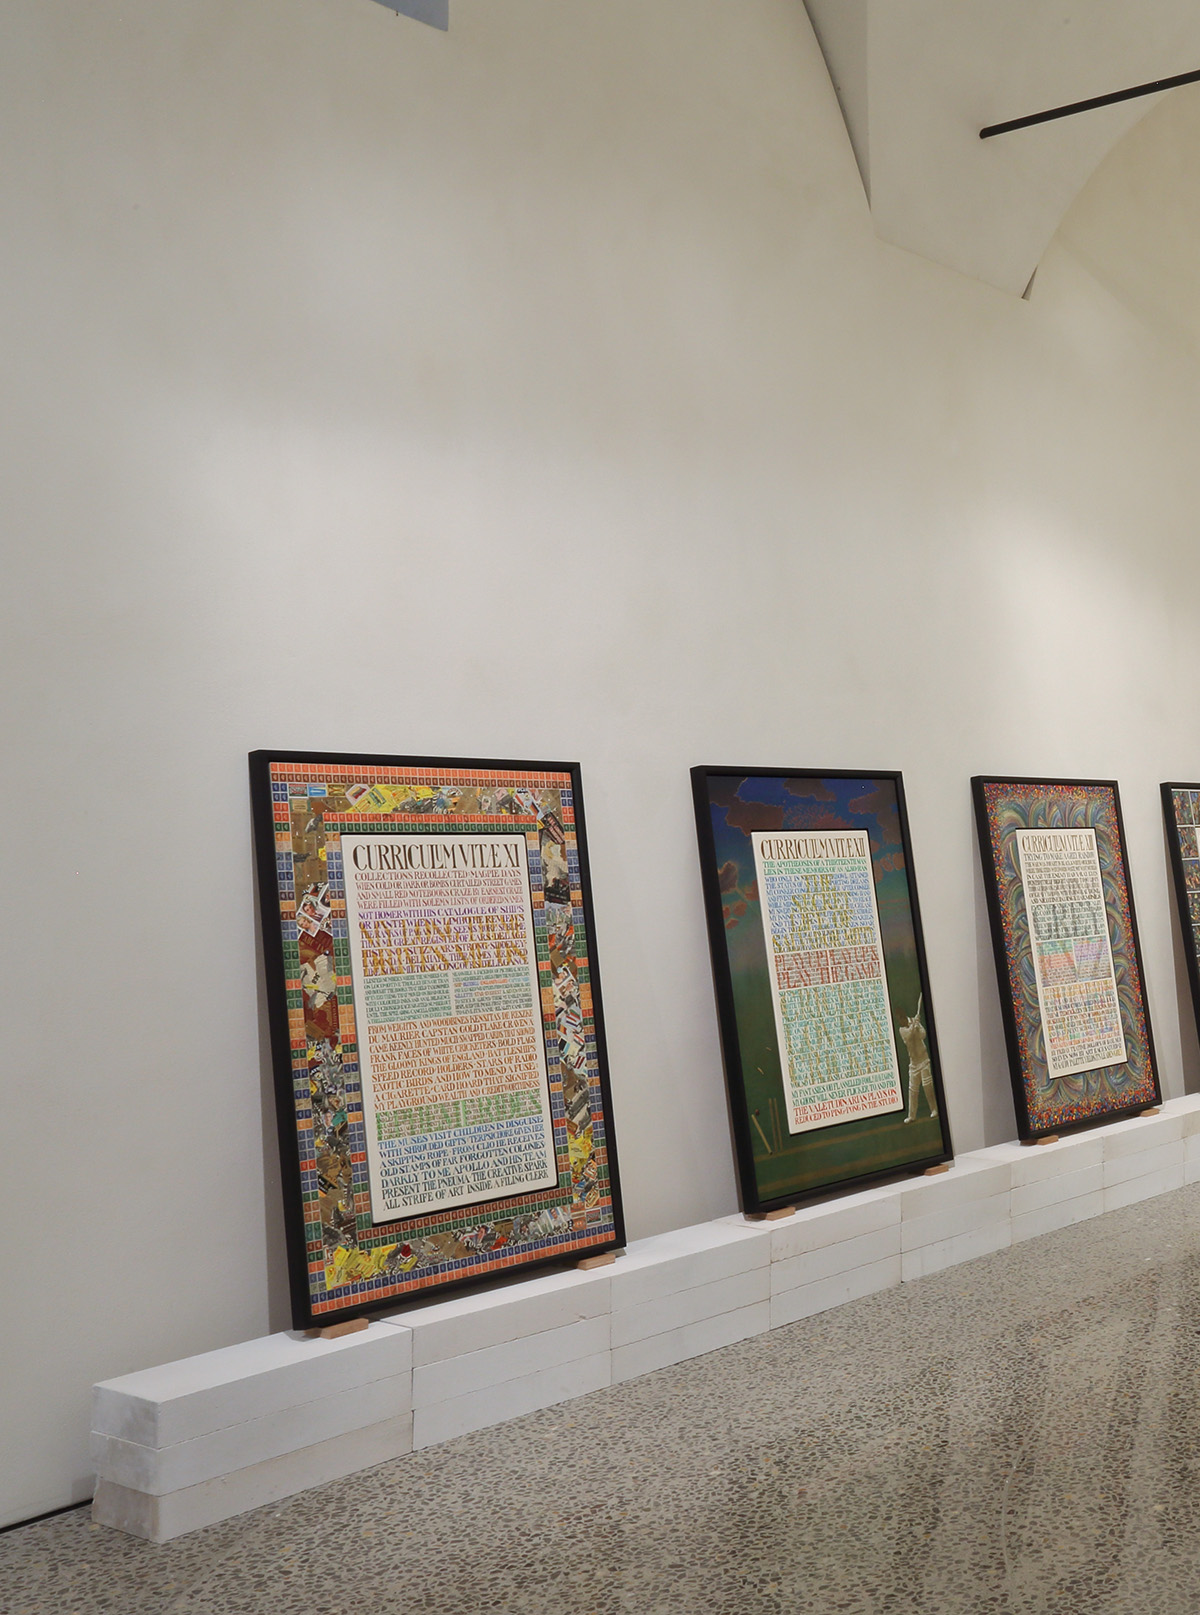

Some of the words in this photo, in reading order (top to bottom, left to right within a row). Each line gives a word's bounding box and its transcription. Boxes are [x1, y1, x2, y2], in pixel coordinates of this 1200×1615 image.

[352, 844, 457, 871] CURRICULUM
[503, 844, 520, 868] XI
[760, 839, 829, 860] CURRICULUM
[354, 871, 413, 881] COLLECTIONS
[501, 869, 521, 877] DAYS
[358, 911, 373, 920] NOT
[374, 910, 403, 919] HOMER
[403, 909, 423, 918] WITH
[424, 909, 436, 917] HIS
[437, 907, 487, 917] CATALOGUE
[488, 906, 499, 914] OF
[500, 905, 524, 914] SHIPS
[369, 1035, 380, 1044] DU
[381, 1030, 421, 1042] MAURIER
[421, 1026, 458, 1038] CAPSTAN
[459, 1024, 480, 1034] GOLD
[480, 1022, 502, 1032] FLAKE
[503, 1019, 528, 1029] CRAVEN
[529, 1018, 534, 1026] A
[373, 1080, 405, 1092] EXOTIC
[406, 1076, 433, 1088] BIRDS
[435, 1074, 452, 1084] AND
[453, 1072, 470, 1081] HOW
[473, 1070, 484, 1079] TO
[484, 1067, 507, 1077] MEND
[508, 1066, 513, 1074] A
[374, 1102, 385, 1111] MY
[387, 1095, 438, 1109] PLAYGROUND
[438, 1090, 467, 1102] WEALTH
[470, 1089, 481, 1097] AND
[794, 1106, 808, 1116] THE
[868, 1090, 887, 1101] PLAYS
[887, 1088, 897, 1097] ON
[795, 1113, 822, 1125] REDUCED
[822, 1111, 830, 1119] TO
[378, 1140, 397, 1150] THE
[398, 1135, 428, 1147] MUSES
[429, 1131, 452, 1141] VISIT
[453, 1124, 495, 1137] CHILDREN
[496, 1122, 504, 1130] IN
[506, 1116, 544, 1129] DISGUISE
[379, 1148, 402, 1159] WITH
[404, 1141, 444, 1155] SHROUDED
[514, 1126, 531, 1136] GIVES
[532, 1124, 544, 1133] HER
[380, 1160, 387, 1168] A
[387, 1153, 426, 1167] SKIPPING
[452, 1144, 475, 1156] FROM
[476, 1141, 495, 1151] CLIO
[496, 1139, 507, 1148] HE
[507, 1132, 545, 1146] RECEIVES
[380, 1167, 398, 1178] OLD
[399, 1161, 431, 1174] STAMPS
[432, 1159, 442, 1168] OF
[442, 1156, 457, 1166] FAR
[459, 1147, 508, 1163] FORGOTTEN
[509, 1141, 545, 1154] COLONIES
[381, 1173, 419, 1188] DARKLY
[421, 1170, 436, 1181] TO
[437, 1167, 451, 1178] ME
[453, 1160, 490, 1175] APOLLO
[490, 1156, 508, 1168] AND
[509, 1154, 522, 1164] HIS
[523, 1149, 547, 1162] TEAM
[382, 1183, 421, 1199] PRESENT
[422, 1180, 437, 1192] THE
[487, 1164, 523, 1179] CREATIVE
[524, 1159, 548, 1172] SPARK
[383, 1198, 400, 1210] ALL
[402, 1192, 433, 1207] STRIFE
[435, 1189, 447, 1200] OF
[447, 1186, 464, 1198] ART
[467, 1180, 492, 1194] INSIDE
[493, 1179, 500, 1188] A
[500, 1174, 525, 1187] FILING
[525, 1169, 549, 1182] CLERK
